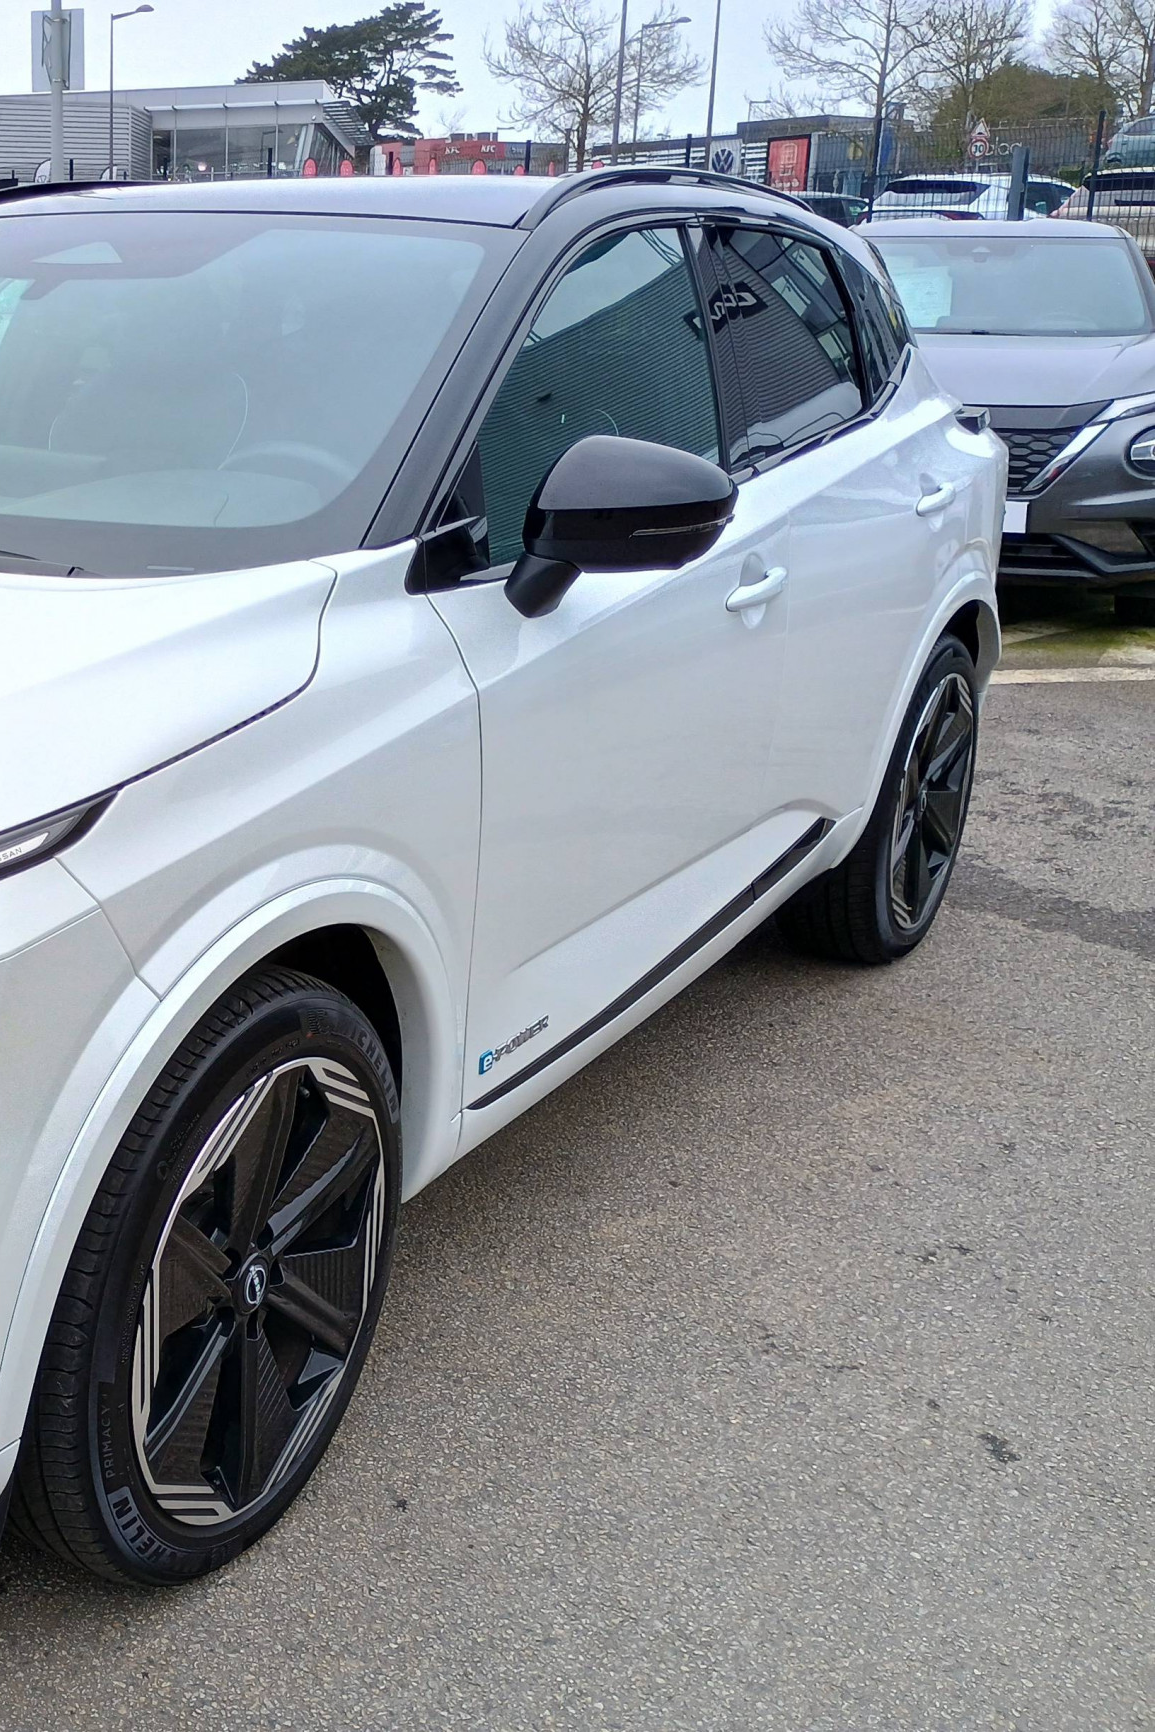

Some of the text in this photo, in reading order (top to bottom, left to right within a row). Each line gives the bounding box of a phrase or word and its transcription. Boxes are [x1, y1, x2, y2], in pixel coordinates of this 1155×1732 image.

[480, 145, 496, 153] KFC
[973, 144, 984, 153] 30
[101, 1404, 116, 1479] PRIMACY
